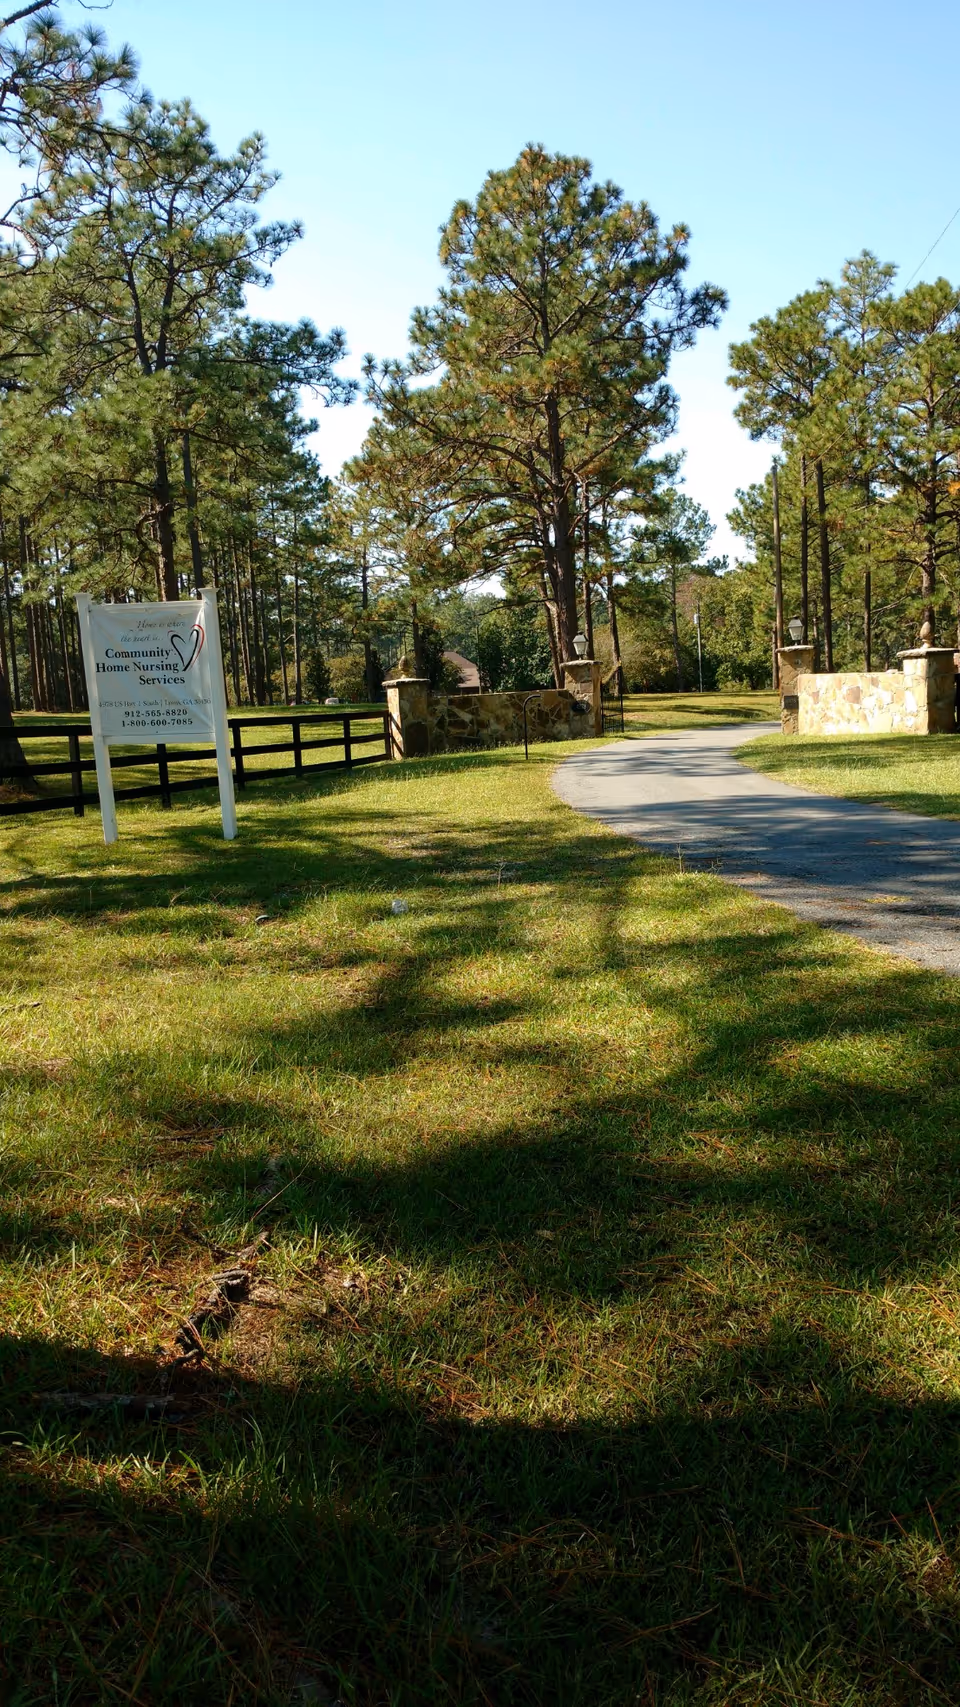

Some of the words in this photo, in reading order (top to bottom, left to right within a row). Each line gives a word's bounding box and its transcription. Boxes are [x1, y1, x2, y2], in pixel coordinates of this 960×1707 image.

[105, 647, 171, 659] Community
[96, 663, 130, 672] Home
[132, 661, 179, 673] Nursing
[139, 674, 185, 685] Services
[124, 708, 188, 718] 912-565-8820
[122, 718, 193, 727] 1-800-600-7085
